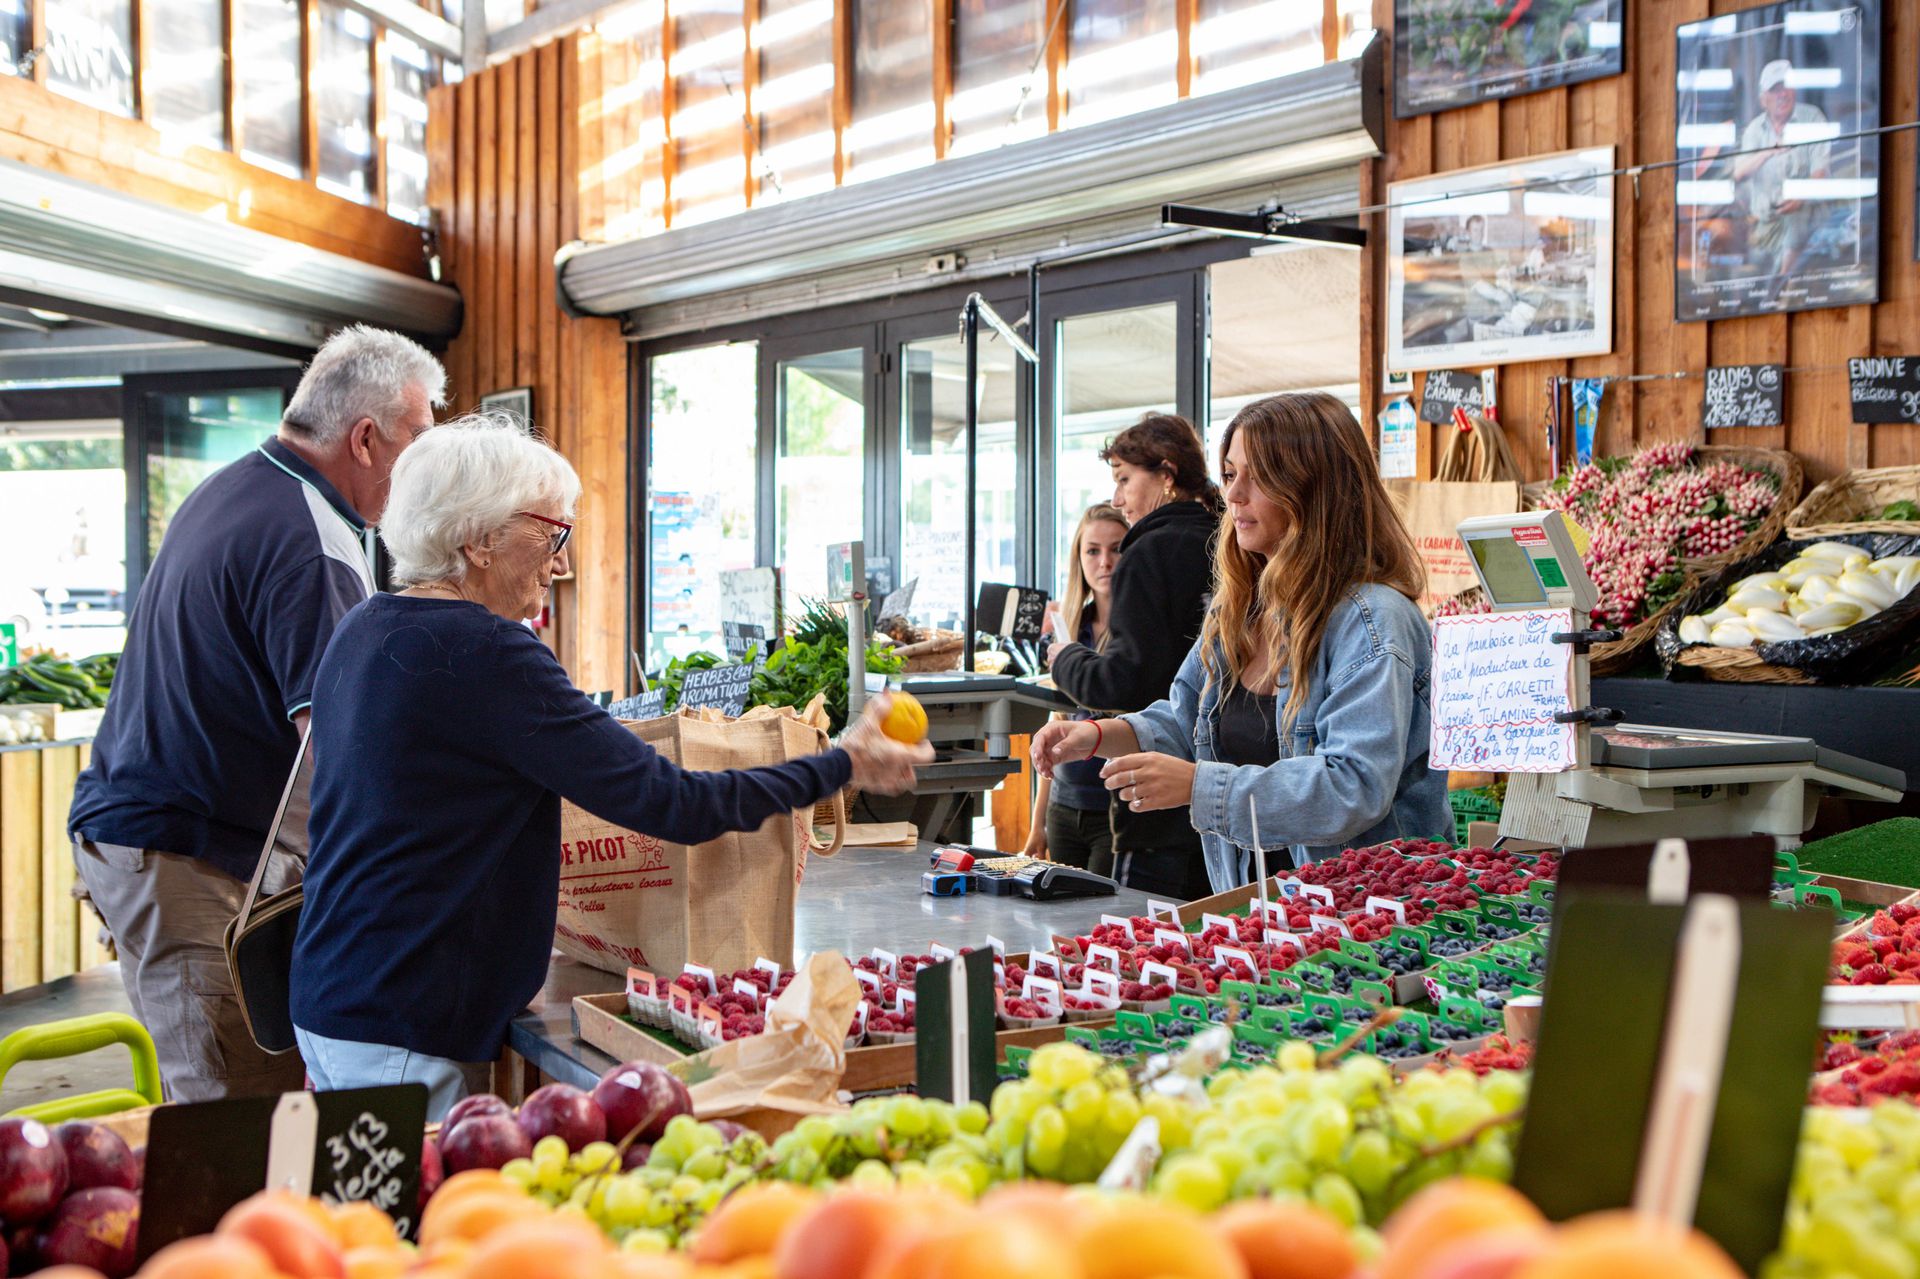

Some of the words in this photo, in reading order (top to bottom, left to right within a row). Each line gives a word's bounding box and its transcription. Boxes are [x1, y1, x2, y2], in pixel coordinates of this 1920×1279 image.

[1708, 366, 1753, 390] RADIS
[1849, 356, 1907, 379] ENDIVE
[1852, 387, 1898, 403] BELGIQUE
[1424, 536, 1453, 550] CABANE
[684, 667, 734, 690] HERBES
[1468, 654, 1529, 687] producteur
[1533, 650, 1555, 669] de
[677, 681, 751, 707] AROMATIQUES
[1496, 675, 1556, 700] CARLETTI
[1531, 693, 1566, 707] FRANCE
[1478, 703, 1537, 724] TULAMINE
[1483, 728, 1498, 743] la
[1503, 721, 1561, 748] barquette
[1547, 741, 1561, 761] 2
[576, 836, 627, 865] PICOT
[572, 882, 635, 898] producteurs
[638, 877, 673, 890] locaux
